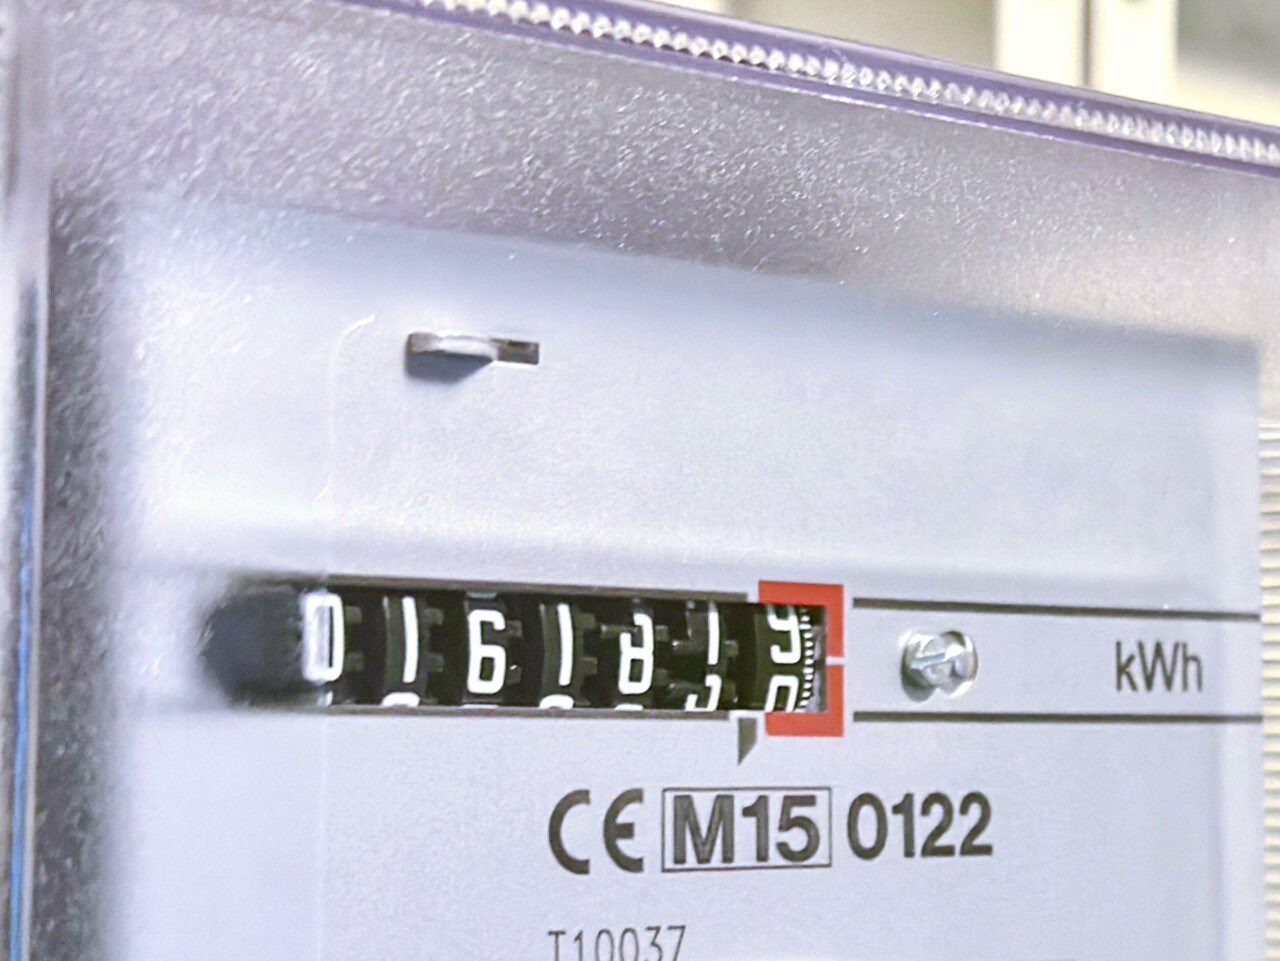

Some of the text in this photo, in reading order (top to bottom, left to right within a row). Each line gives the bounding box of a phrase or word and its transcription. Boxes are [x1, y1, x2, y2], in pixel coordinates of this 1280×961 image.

[1116, 640, 1203, 692] kWh
[672, 795, 820, 865] M15
[847, 792, 993, 860] 0122
